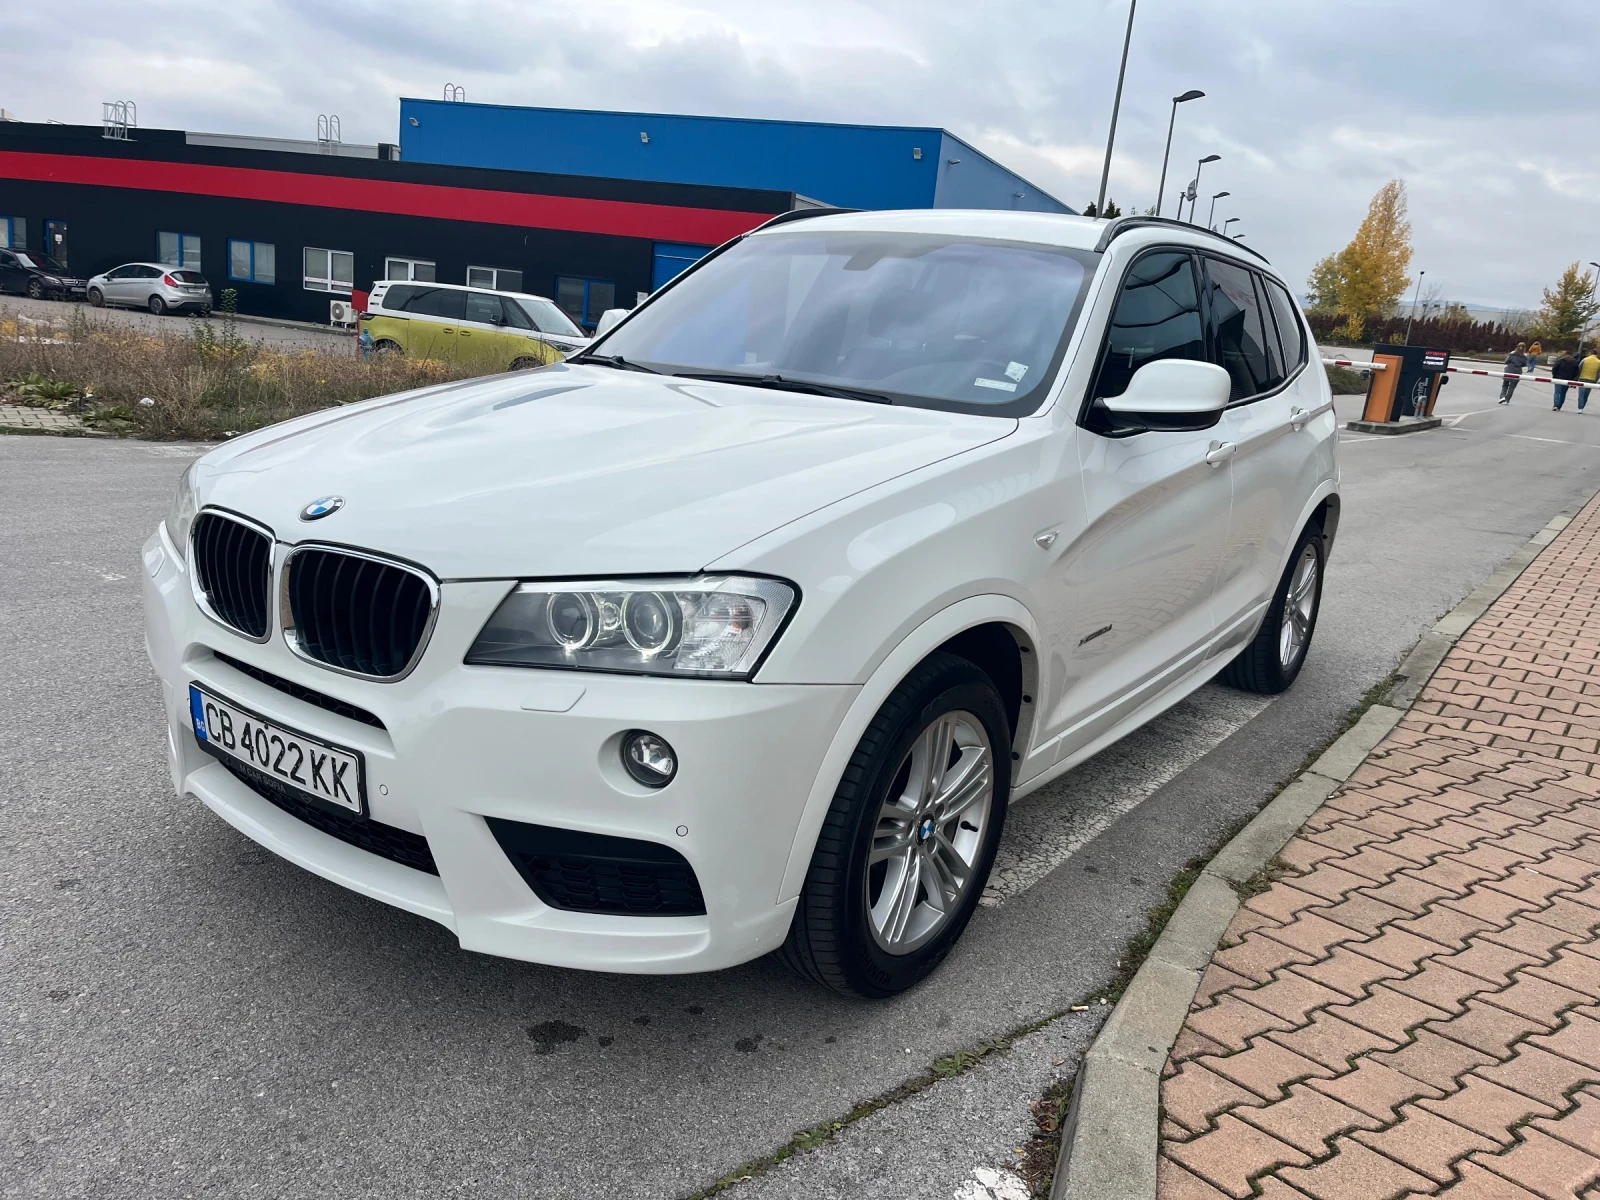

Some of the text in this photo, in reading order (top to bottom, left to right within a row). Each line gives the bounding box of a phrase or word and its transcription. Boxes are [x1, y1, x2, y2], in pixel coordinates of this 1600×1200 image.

[195, 717, 206, 732] BG
[205, 702, 353, 804] CB 4022 KK
[262, 775, 287, 793] SOFIA
